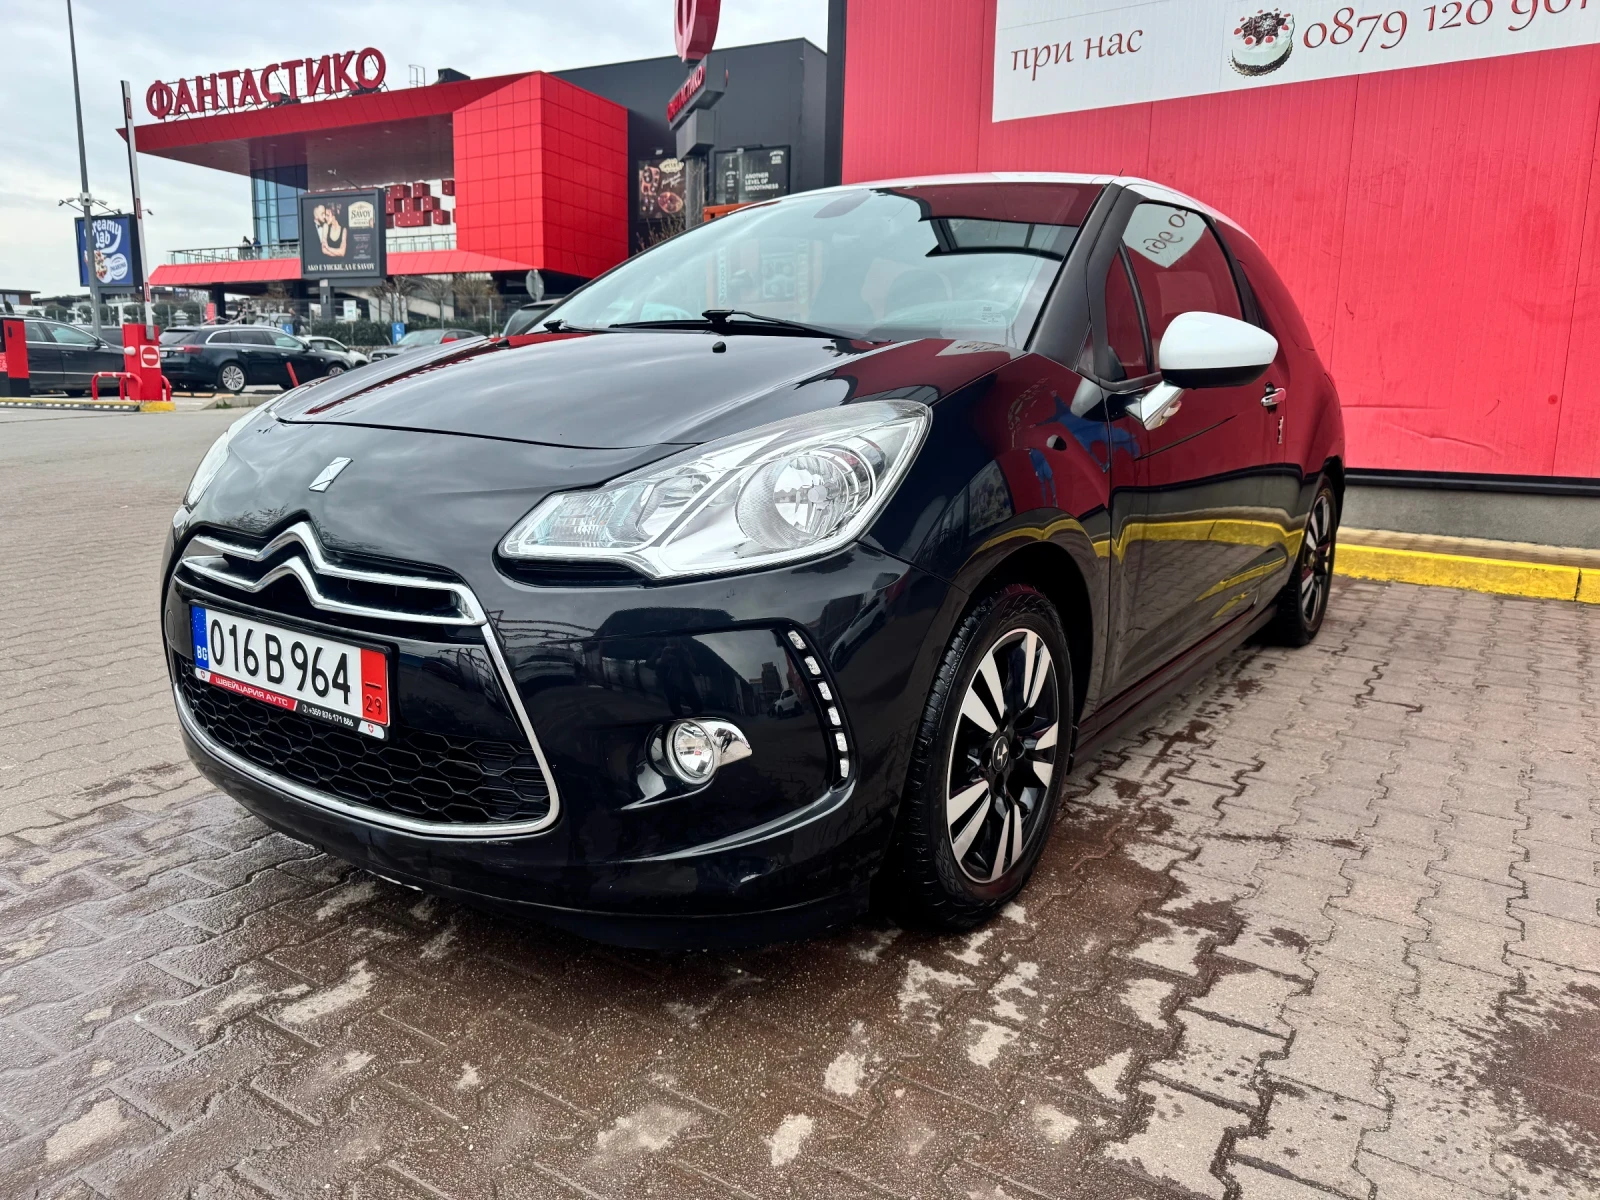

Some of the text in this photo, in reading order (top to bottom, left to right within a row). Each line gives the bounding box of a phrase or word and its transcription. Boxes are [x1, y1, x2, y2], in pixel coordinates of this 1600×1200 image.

[1303, 6, 1407, 53] 0879
[1422, 0, 1493, 32] 120
[1010, 29, 1143, 81] при нас
[146, 47, 386, 119] ФАНТАСТИКО
[351, 209, 371, 220] SAVOY
[197, 645, 208, 661] BG
[215, 676, 265, 699] ШВЕЙЦАРИЯ
[365, 694, 383, 716] 29
